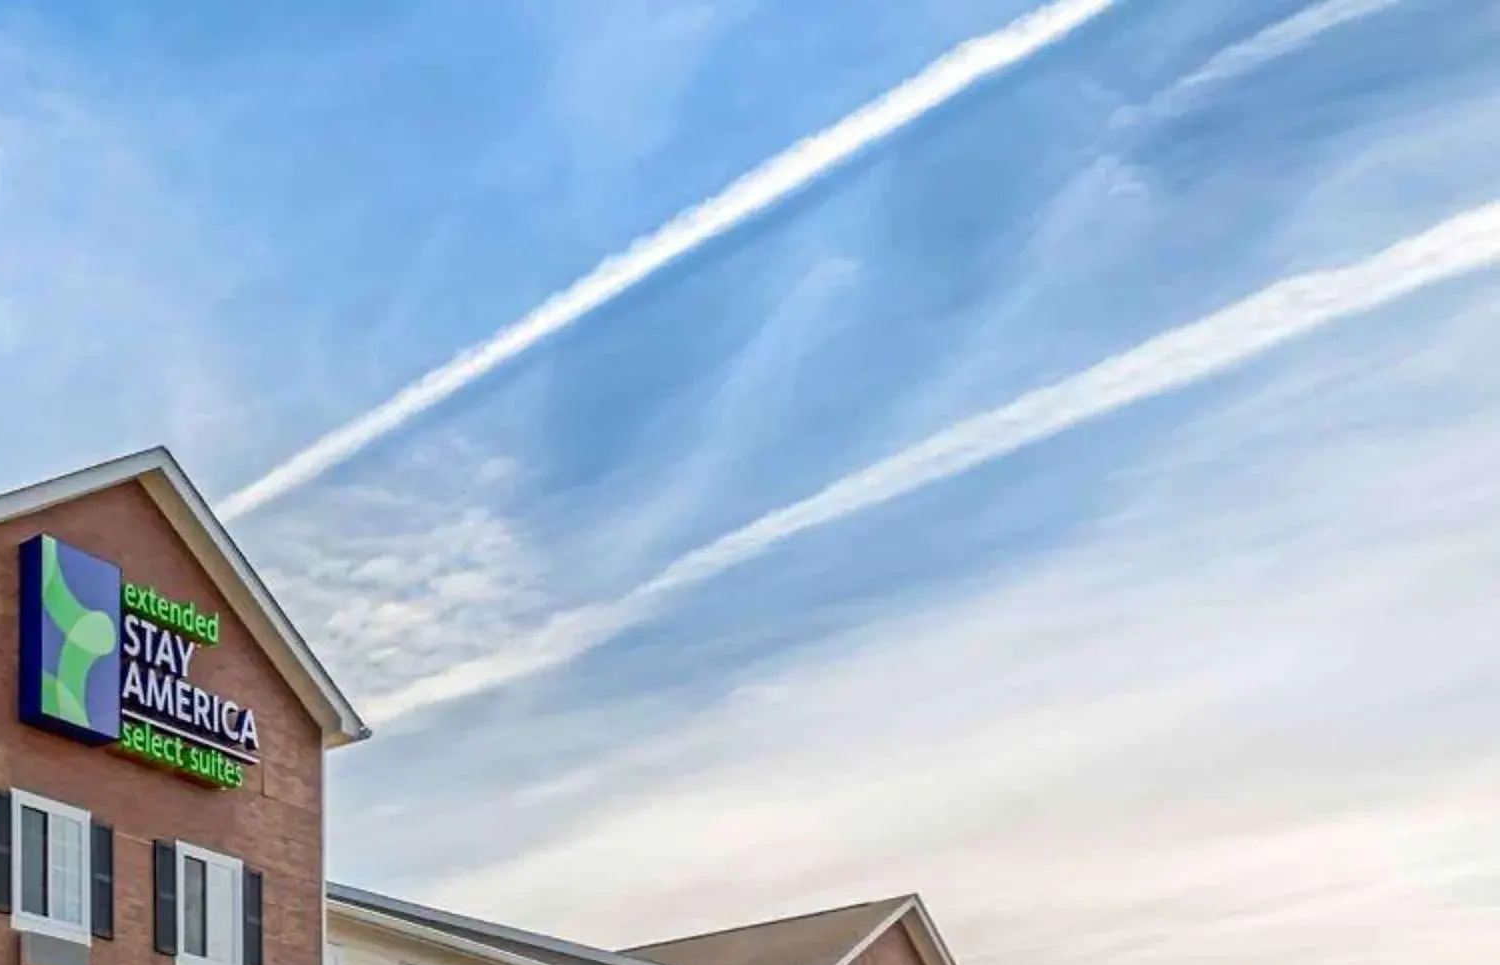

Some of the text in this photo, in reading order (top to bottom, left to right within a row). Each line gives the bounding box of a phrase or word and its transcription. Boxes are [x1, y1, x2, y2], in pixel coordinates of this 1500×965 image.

[125, 583, 220, 643] extended
[123, 615, 195, 677] STAY
[123, 661, 259, 749] AMERICA
[122, 722, 243, 786] select suites
